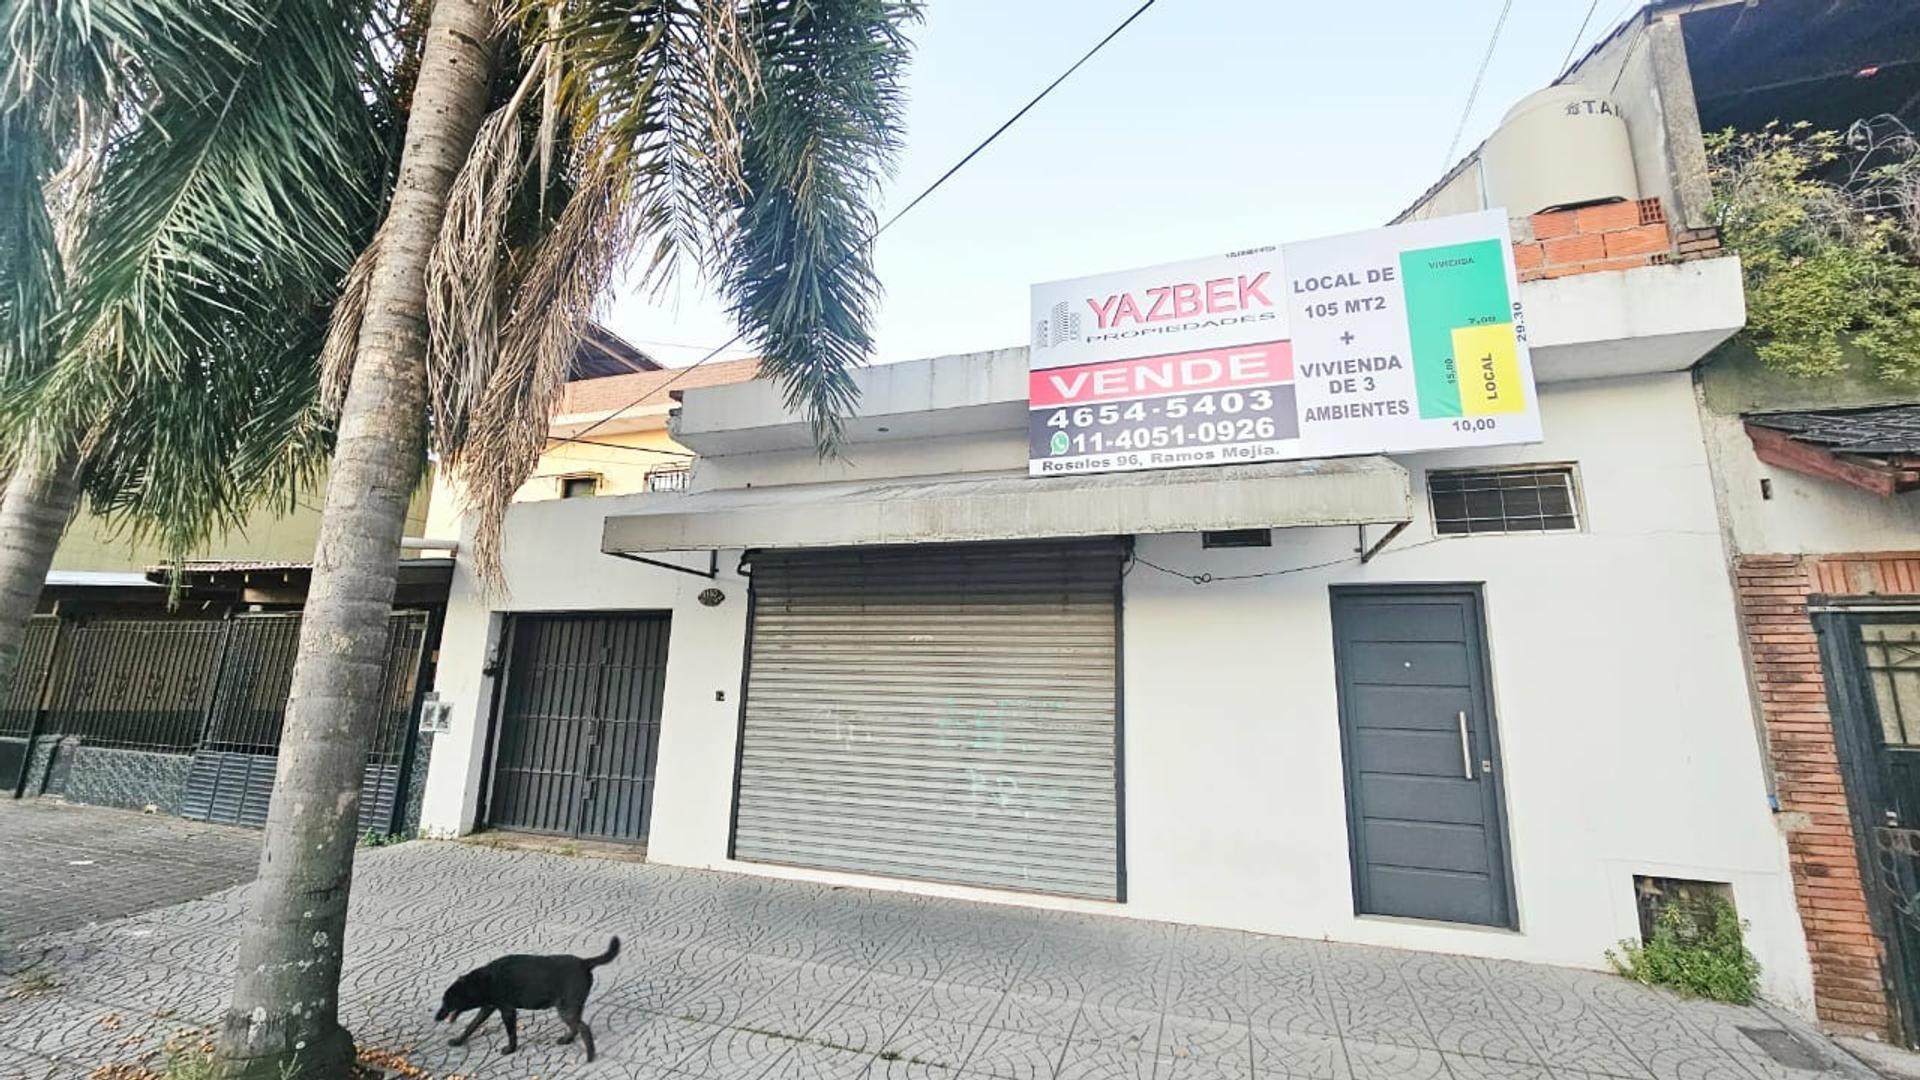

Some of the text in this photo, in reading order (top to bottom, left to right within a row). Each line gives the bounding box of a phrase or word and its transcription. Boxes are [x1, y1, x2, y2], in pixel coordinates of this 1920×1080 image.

[1294, 267, 1395, 293] LOCAL DE
[1086, 272, 1273, 329] YAZBEK
[1305, 296, 1386, 319] 105 MT2
[1086, 311, 1276, 343] PROPIEDADES
[1050, 353, 1270, 399] VENDE
[1300, 355, 1402, 378] VIVIENDA
[1482, 353, 1498, 400] LOCAL
[1329, 377, 1376, 394] DE 3
[1047, 389, 1273, 428] 4654-5403
[1305, 399, 1409, 422] AMBIENTES
[1072, 417, 1275, 452] 11-4051-0926
[1452, 418, 1496, 432] 10,00
[1042, 458, 1111, 472] Rosales
[1117, 454, 1143, 467] 96,
[1150, 451, 1215, 463] Ramos
